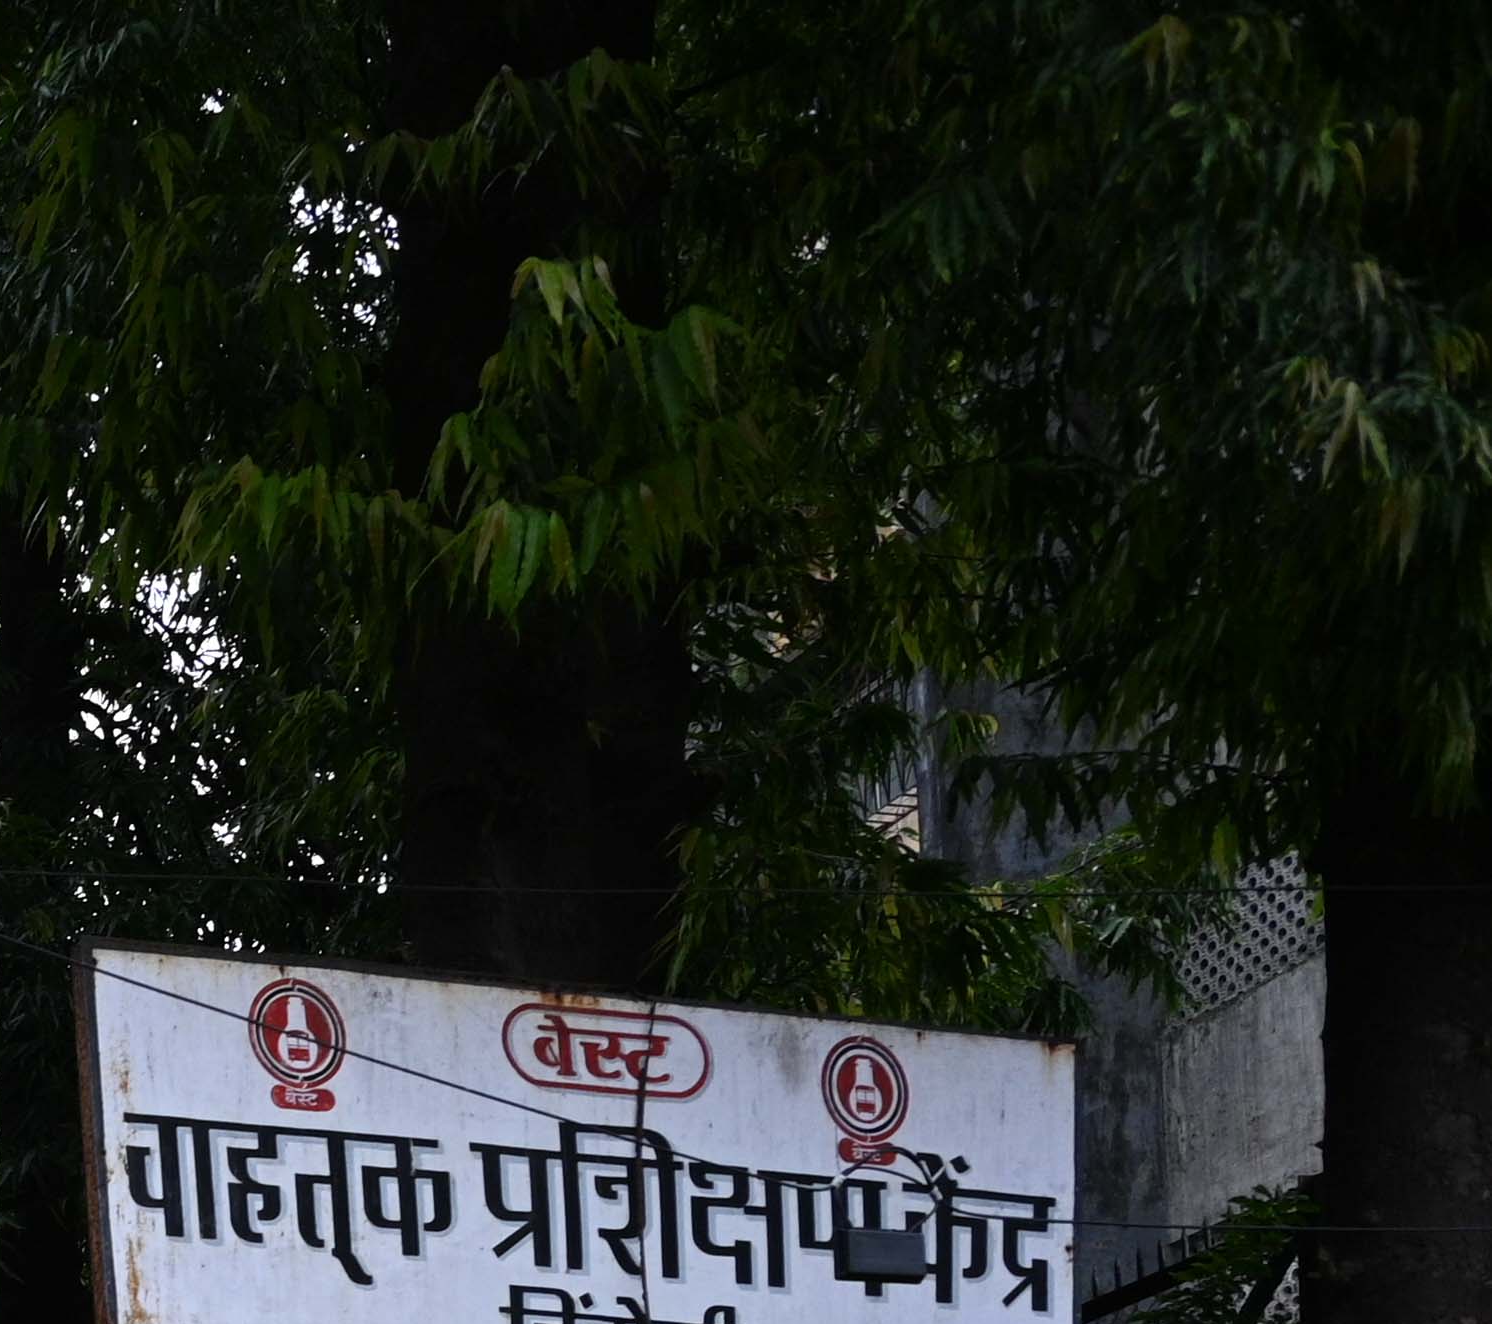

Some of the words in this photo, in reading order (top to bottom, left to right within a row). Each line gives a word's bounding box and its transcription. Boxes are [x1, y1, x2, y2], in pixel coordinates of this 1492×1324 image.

[533, 1013, 674, 1083] बेस्ट
[124, 1112, 452, 1287] वाहतूक
[470, 1120, 887, 1296] प्रशिक्षण
